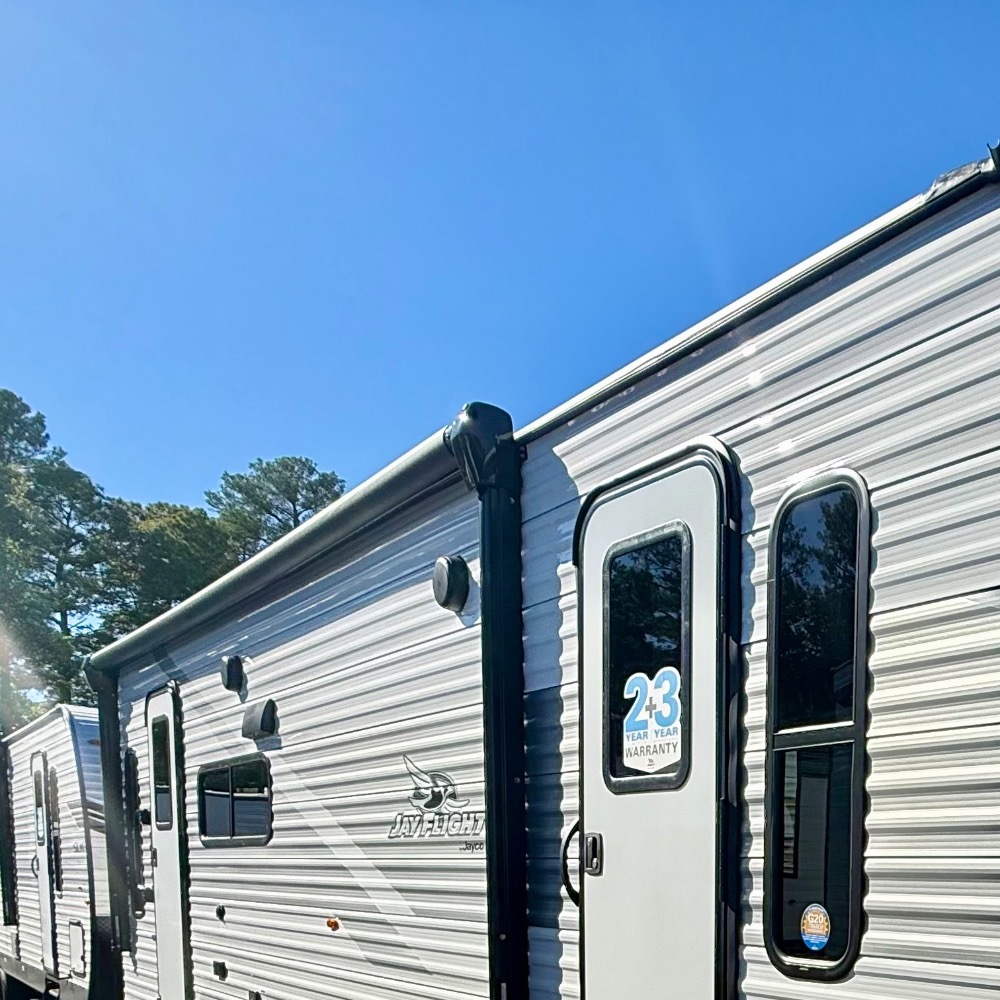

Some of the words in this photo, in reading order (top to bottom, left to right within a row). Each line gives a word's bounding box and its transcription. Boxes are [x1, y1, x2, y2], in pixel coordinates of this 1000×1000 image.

[626, 731, 649, 742] YEAR
[654, 727, 679, 738] YEAR
[625, 741, 679, 758] WARRANTY
[464, 841, 485, 853] Jayco
